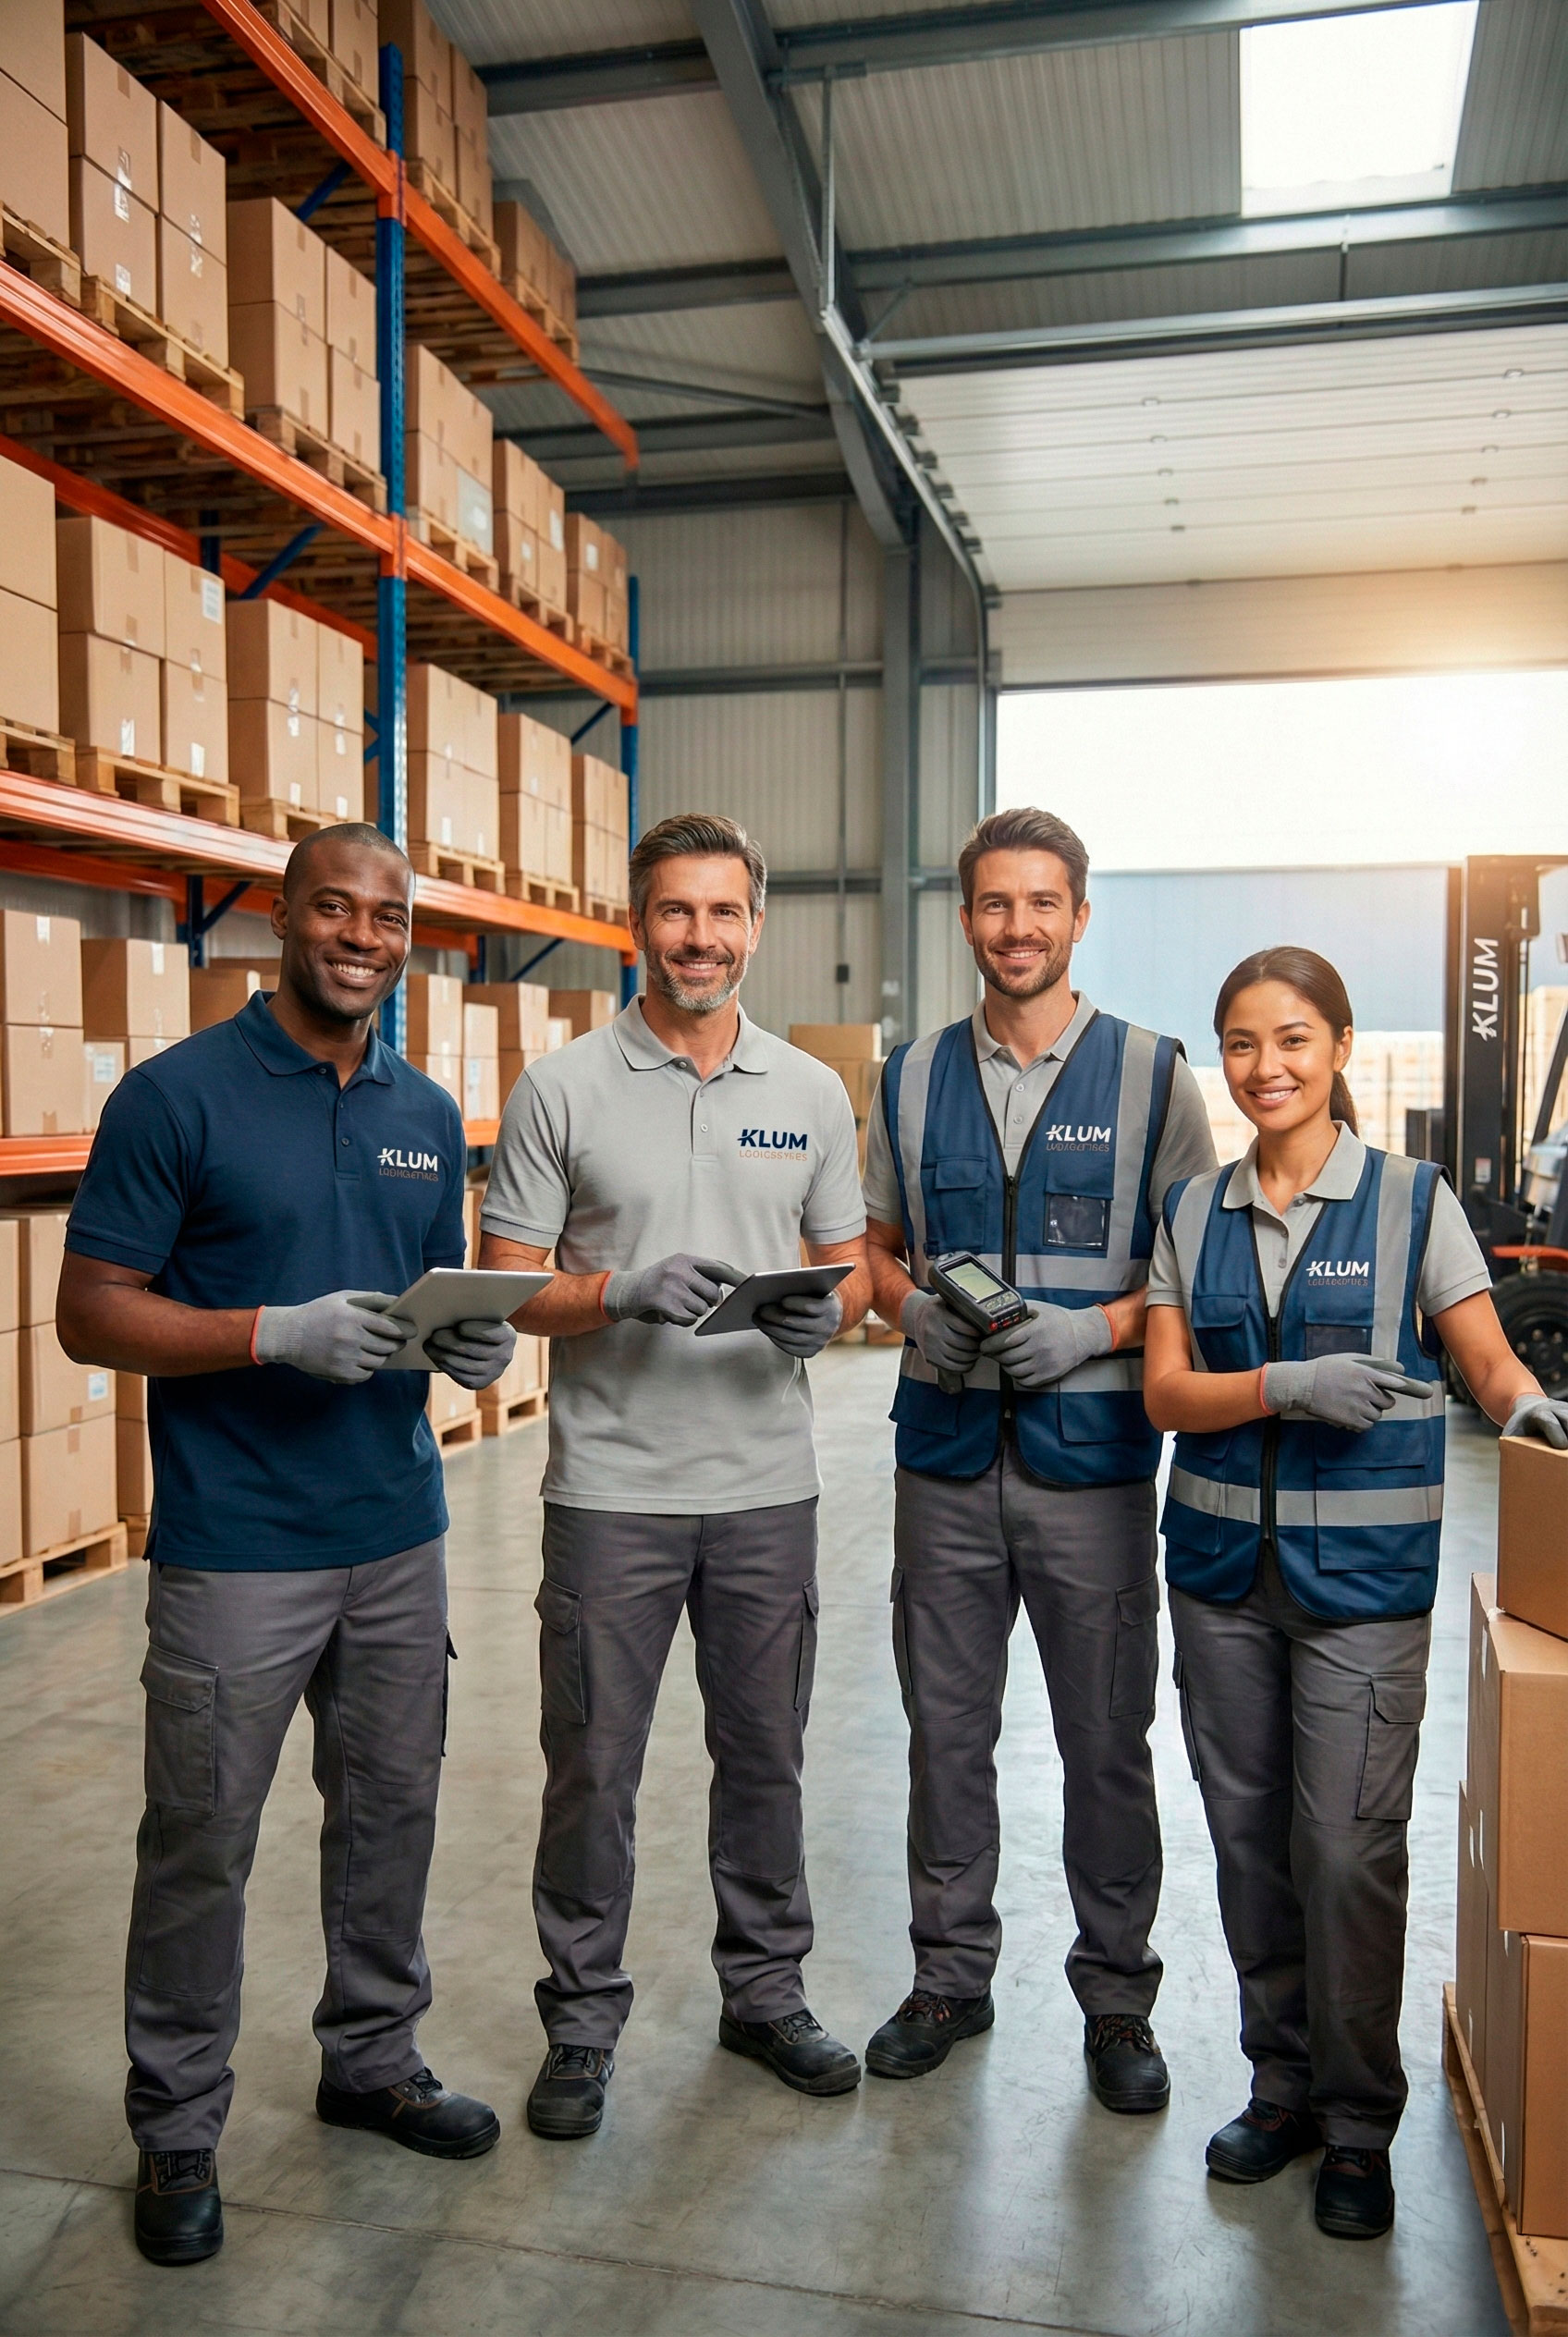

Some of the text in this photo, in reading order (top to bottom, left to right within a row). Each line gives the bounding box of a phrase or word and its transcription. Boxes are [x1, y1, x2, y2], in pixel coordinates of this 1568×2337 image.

[1472, 937, 1499, 1042] KLUM
[737, 1129, 808, 1150] KLUM
[1045, 1124, 1111, 1143] KLUM
[376, 1147, 438, 1172] KLUM
[1305, 1260, 1370, 1278] KLUM
